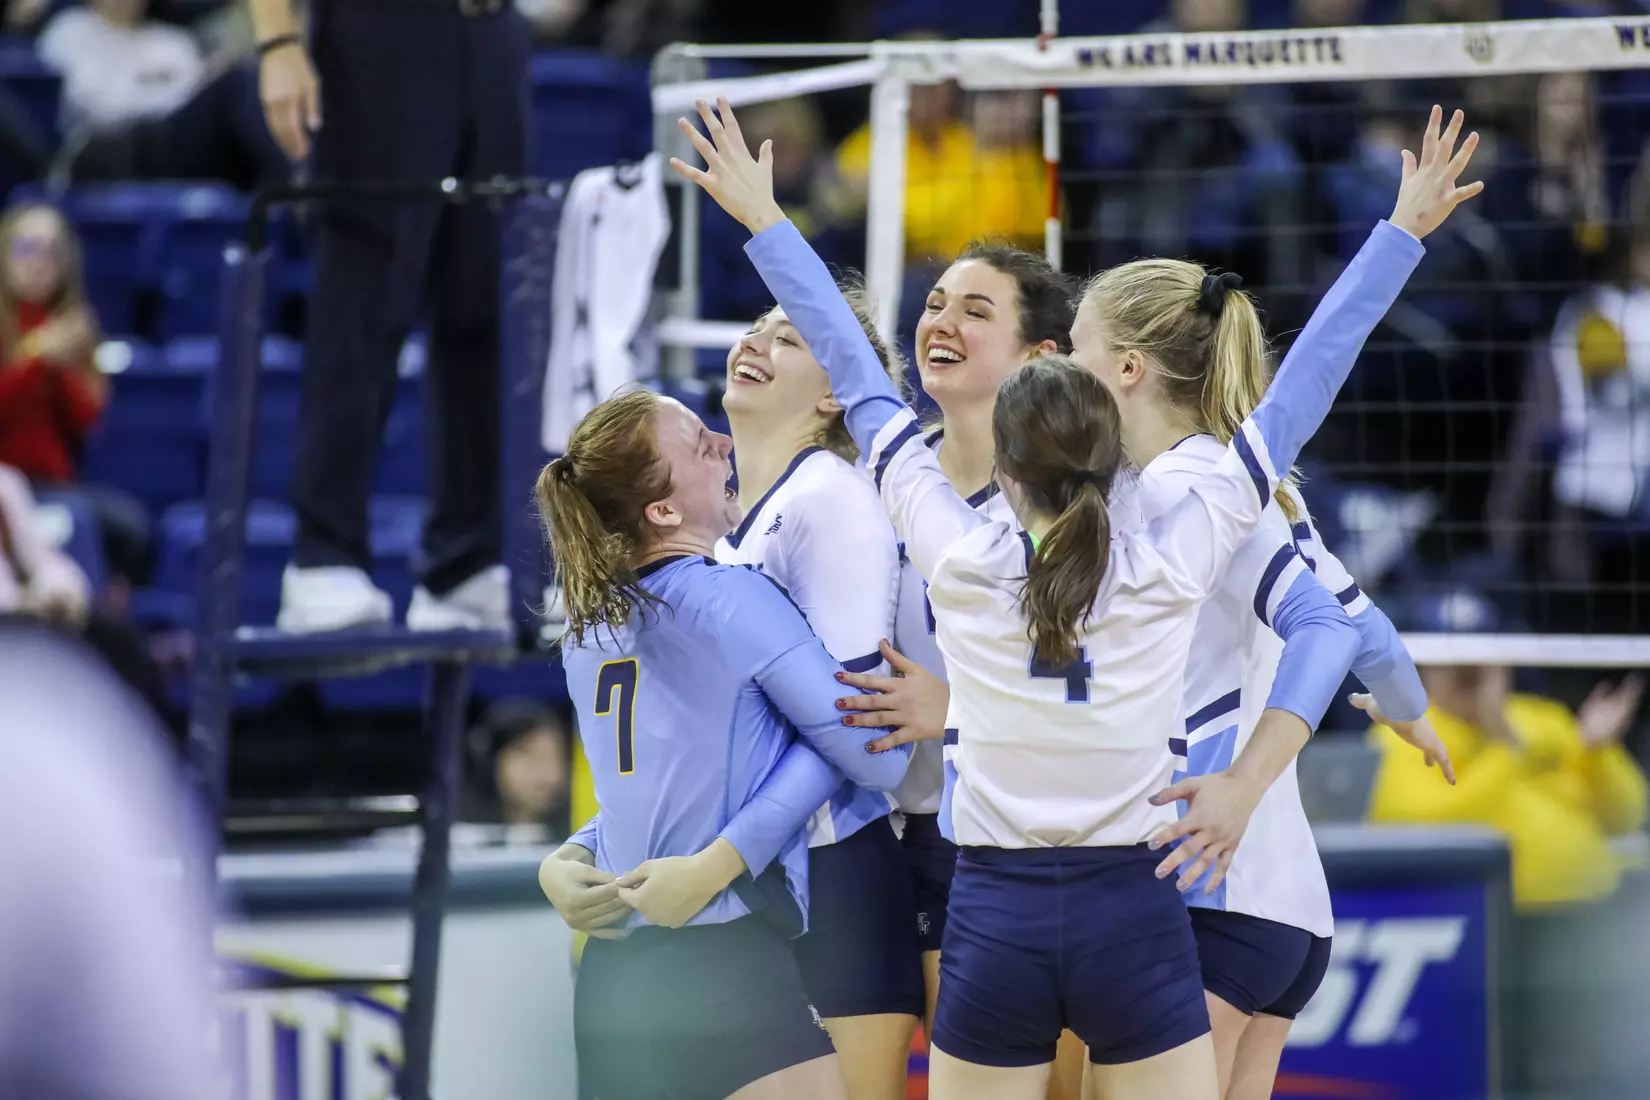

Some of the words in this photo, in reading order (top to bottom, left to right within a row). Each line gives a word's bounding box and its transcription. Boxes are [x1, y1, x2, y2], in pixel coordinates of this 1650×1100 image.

[1075, 46, 1112, 70] WE
[1123, 43, 1172, 67] ARE
[1184, 36, 1344, 67] MARQUETTE
[1028, 638, 1093, 704] 4
[594, 656, 639, 775] 7
